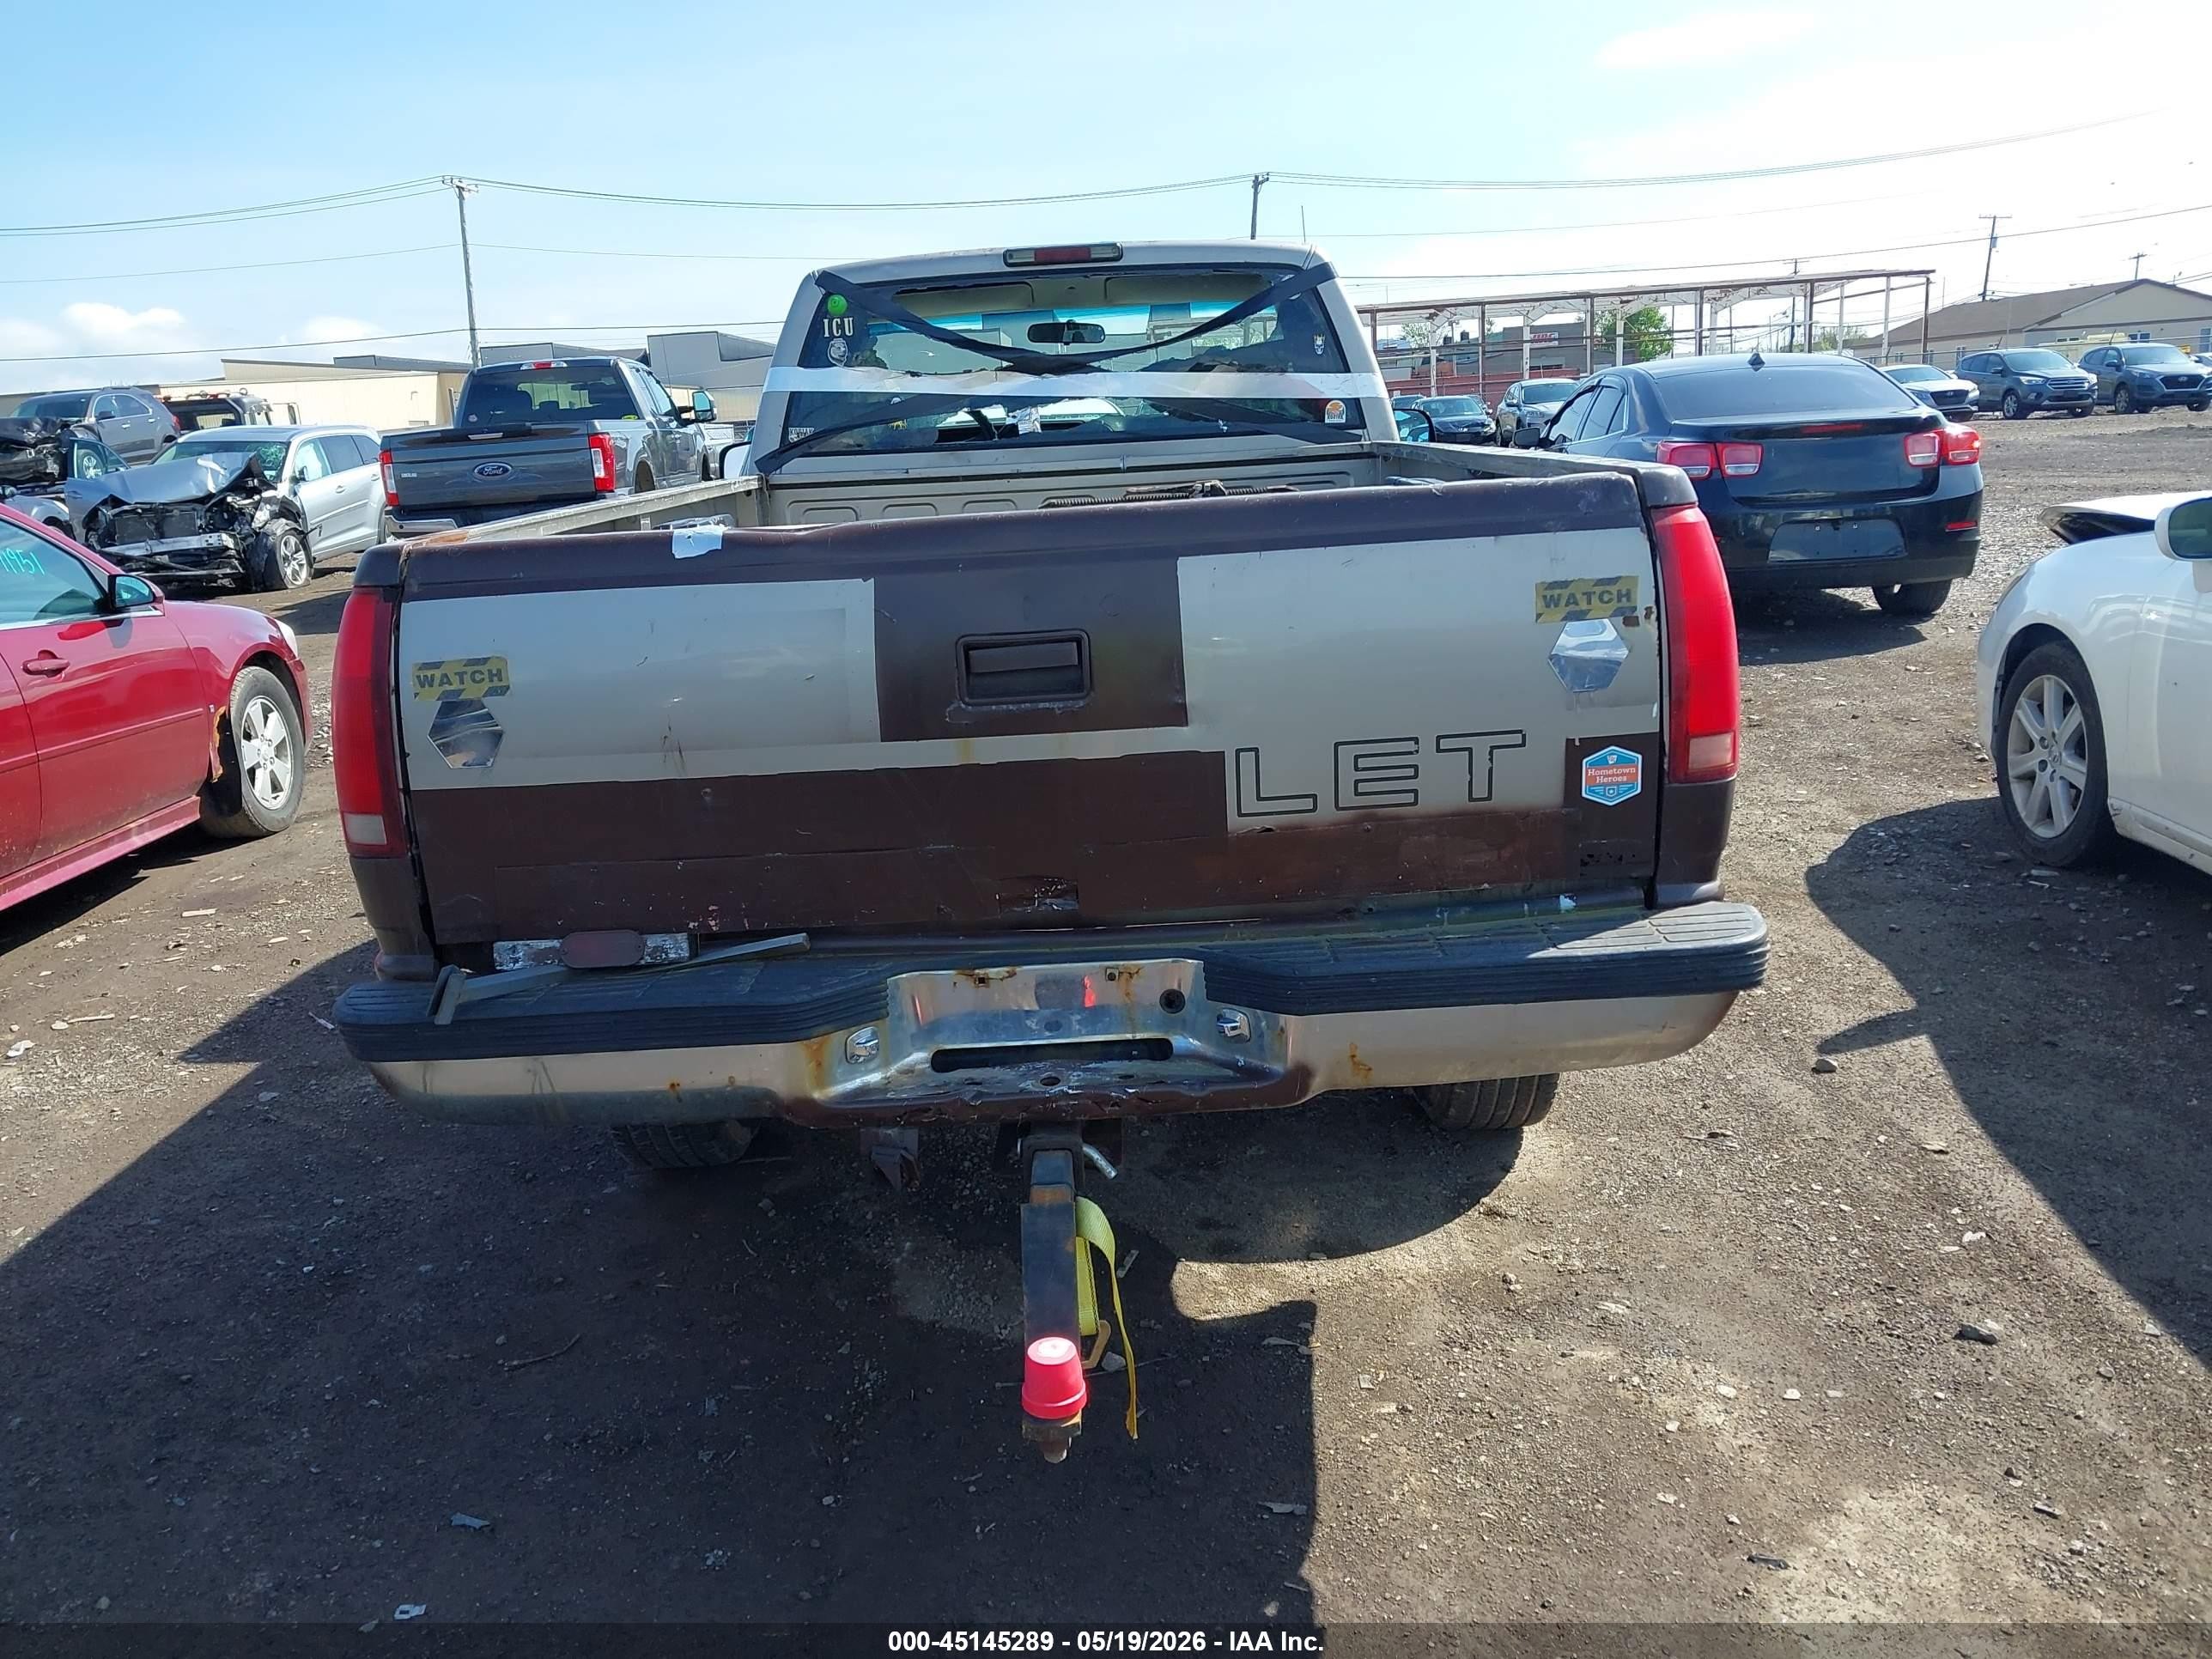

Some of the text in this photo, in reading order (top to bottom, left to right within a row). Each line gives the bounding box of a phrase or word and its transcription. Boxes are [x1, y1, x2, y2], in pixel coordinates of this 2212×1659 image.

[823, 317, 854, 337] ICU
[483, 466, 503, 476] Ford
[1542, 588, 1632, 609] WATCH
[416, 668, 503, 689] WATCH
[1235, 729, 1527, 817] LET
[1588, 768, 1636, 776] Hometown
[1595, 775, 1627, 784] Heroes
